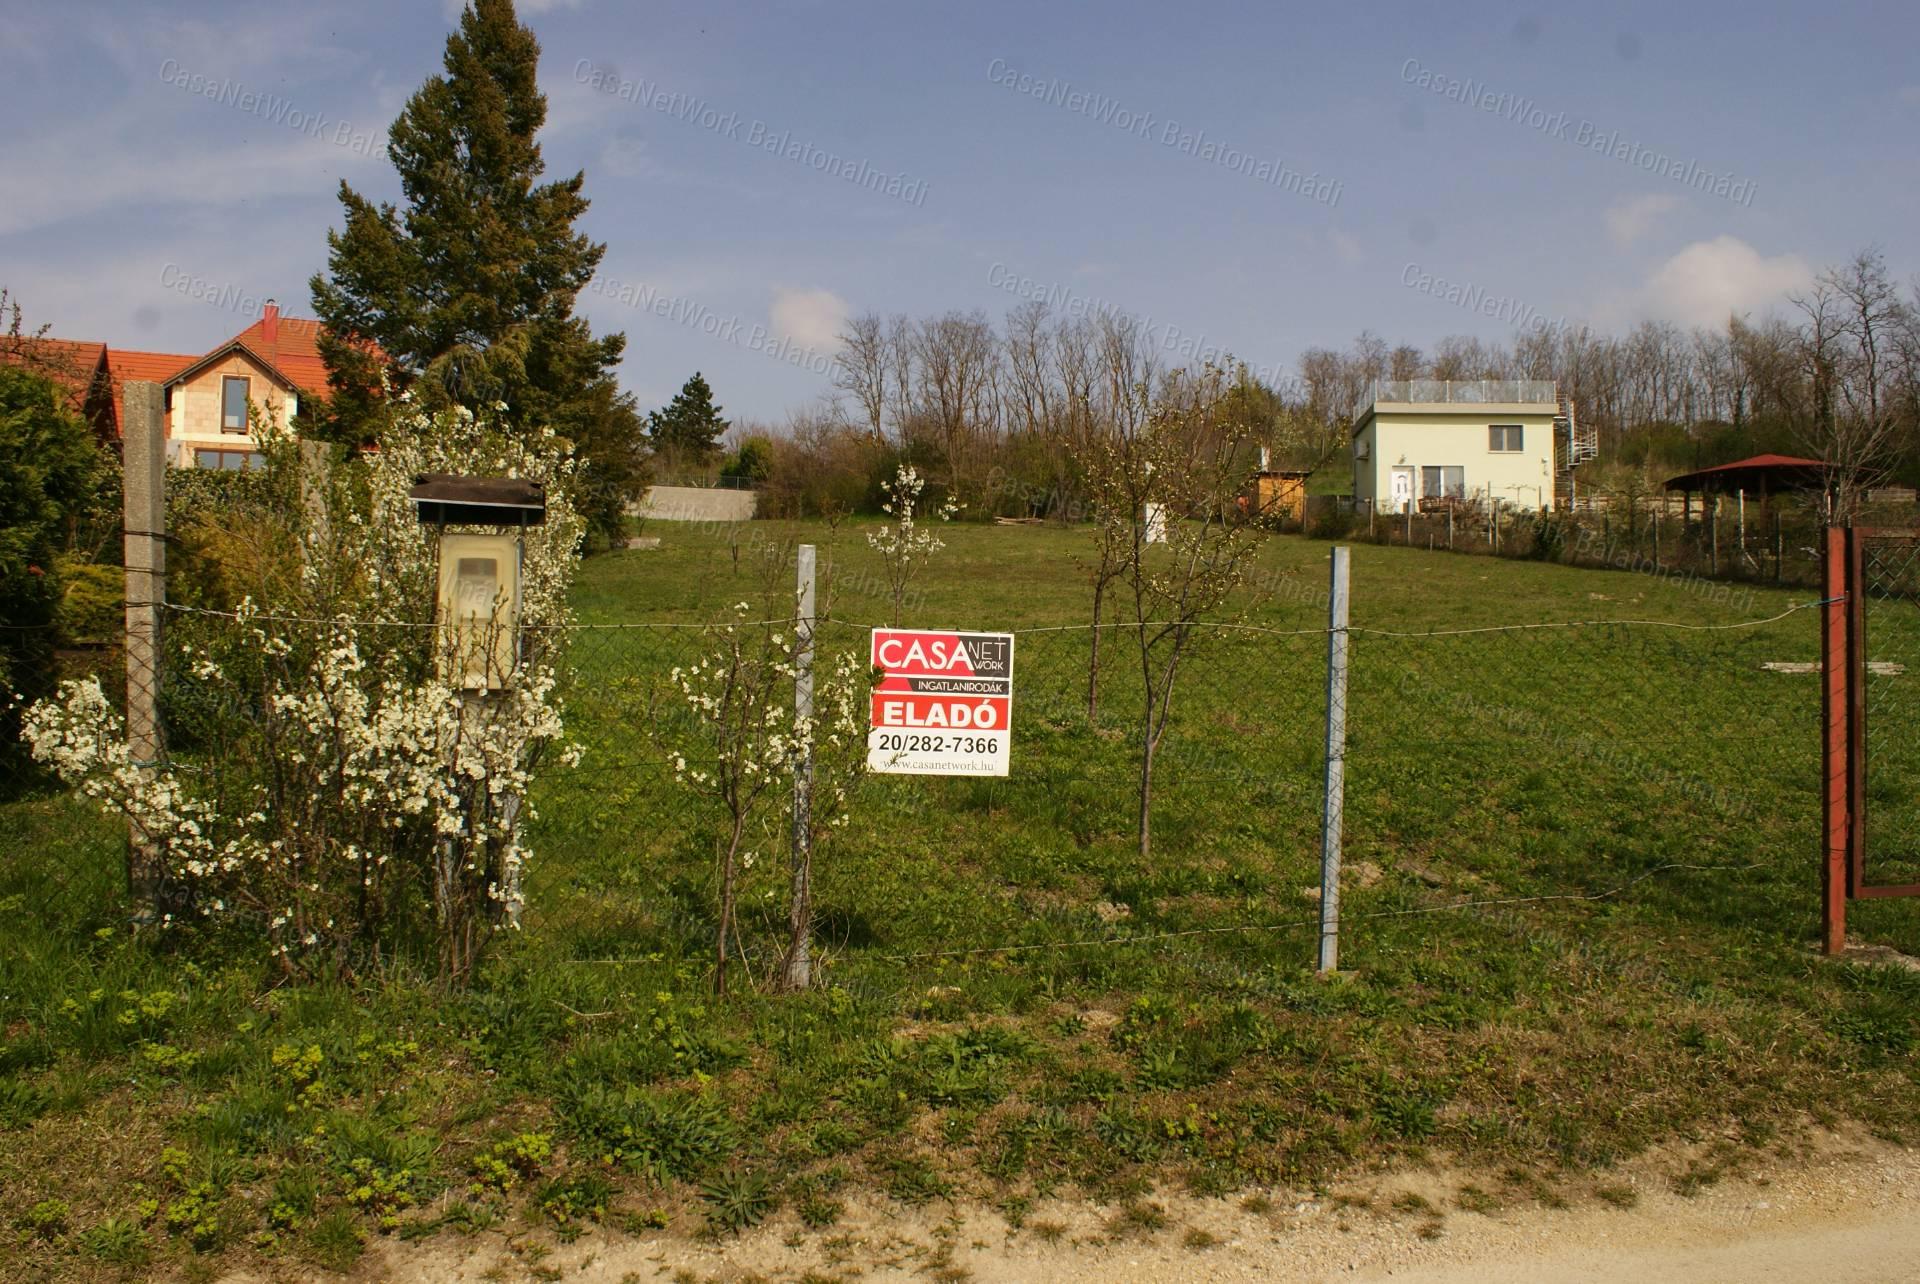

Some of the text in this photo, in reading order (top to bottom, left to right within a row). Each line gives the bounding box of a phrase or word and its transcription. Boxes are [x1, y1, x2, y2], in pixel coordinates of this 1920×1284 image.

[878, 639, 1007, 671] CASA NET
[974, 660, 1004, 671] WORK
[918, 680, 1003, 693] INGATLANIRODÁK
[883, 698, 997, 729] ELADÓ
[878, 734, 998, 754] 20/282-7366
[882, 759, 994, 771] www.casanetwork.hu
